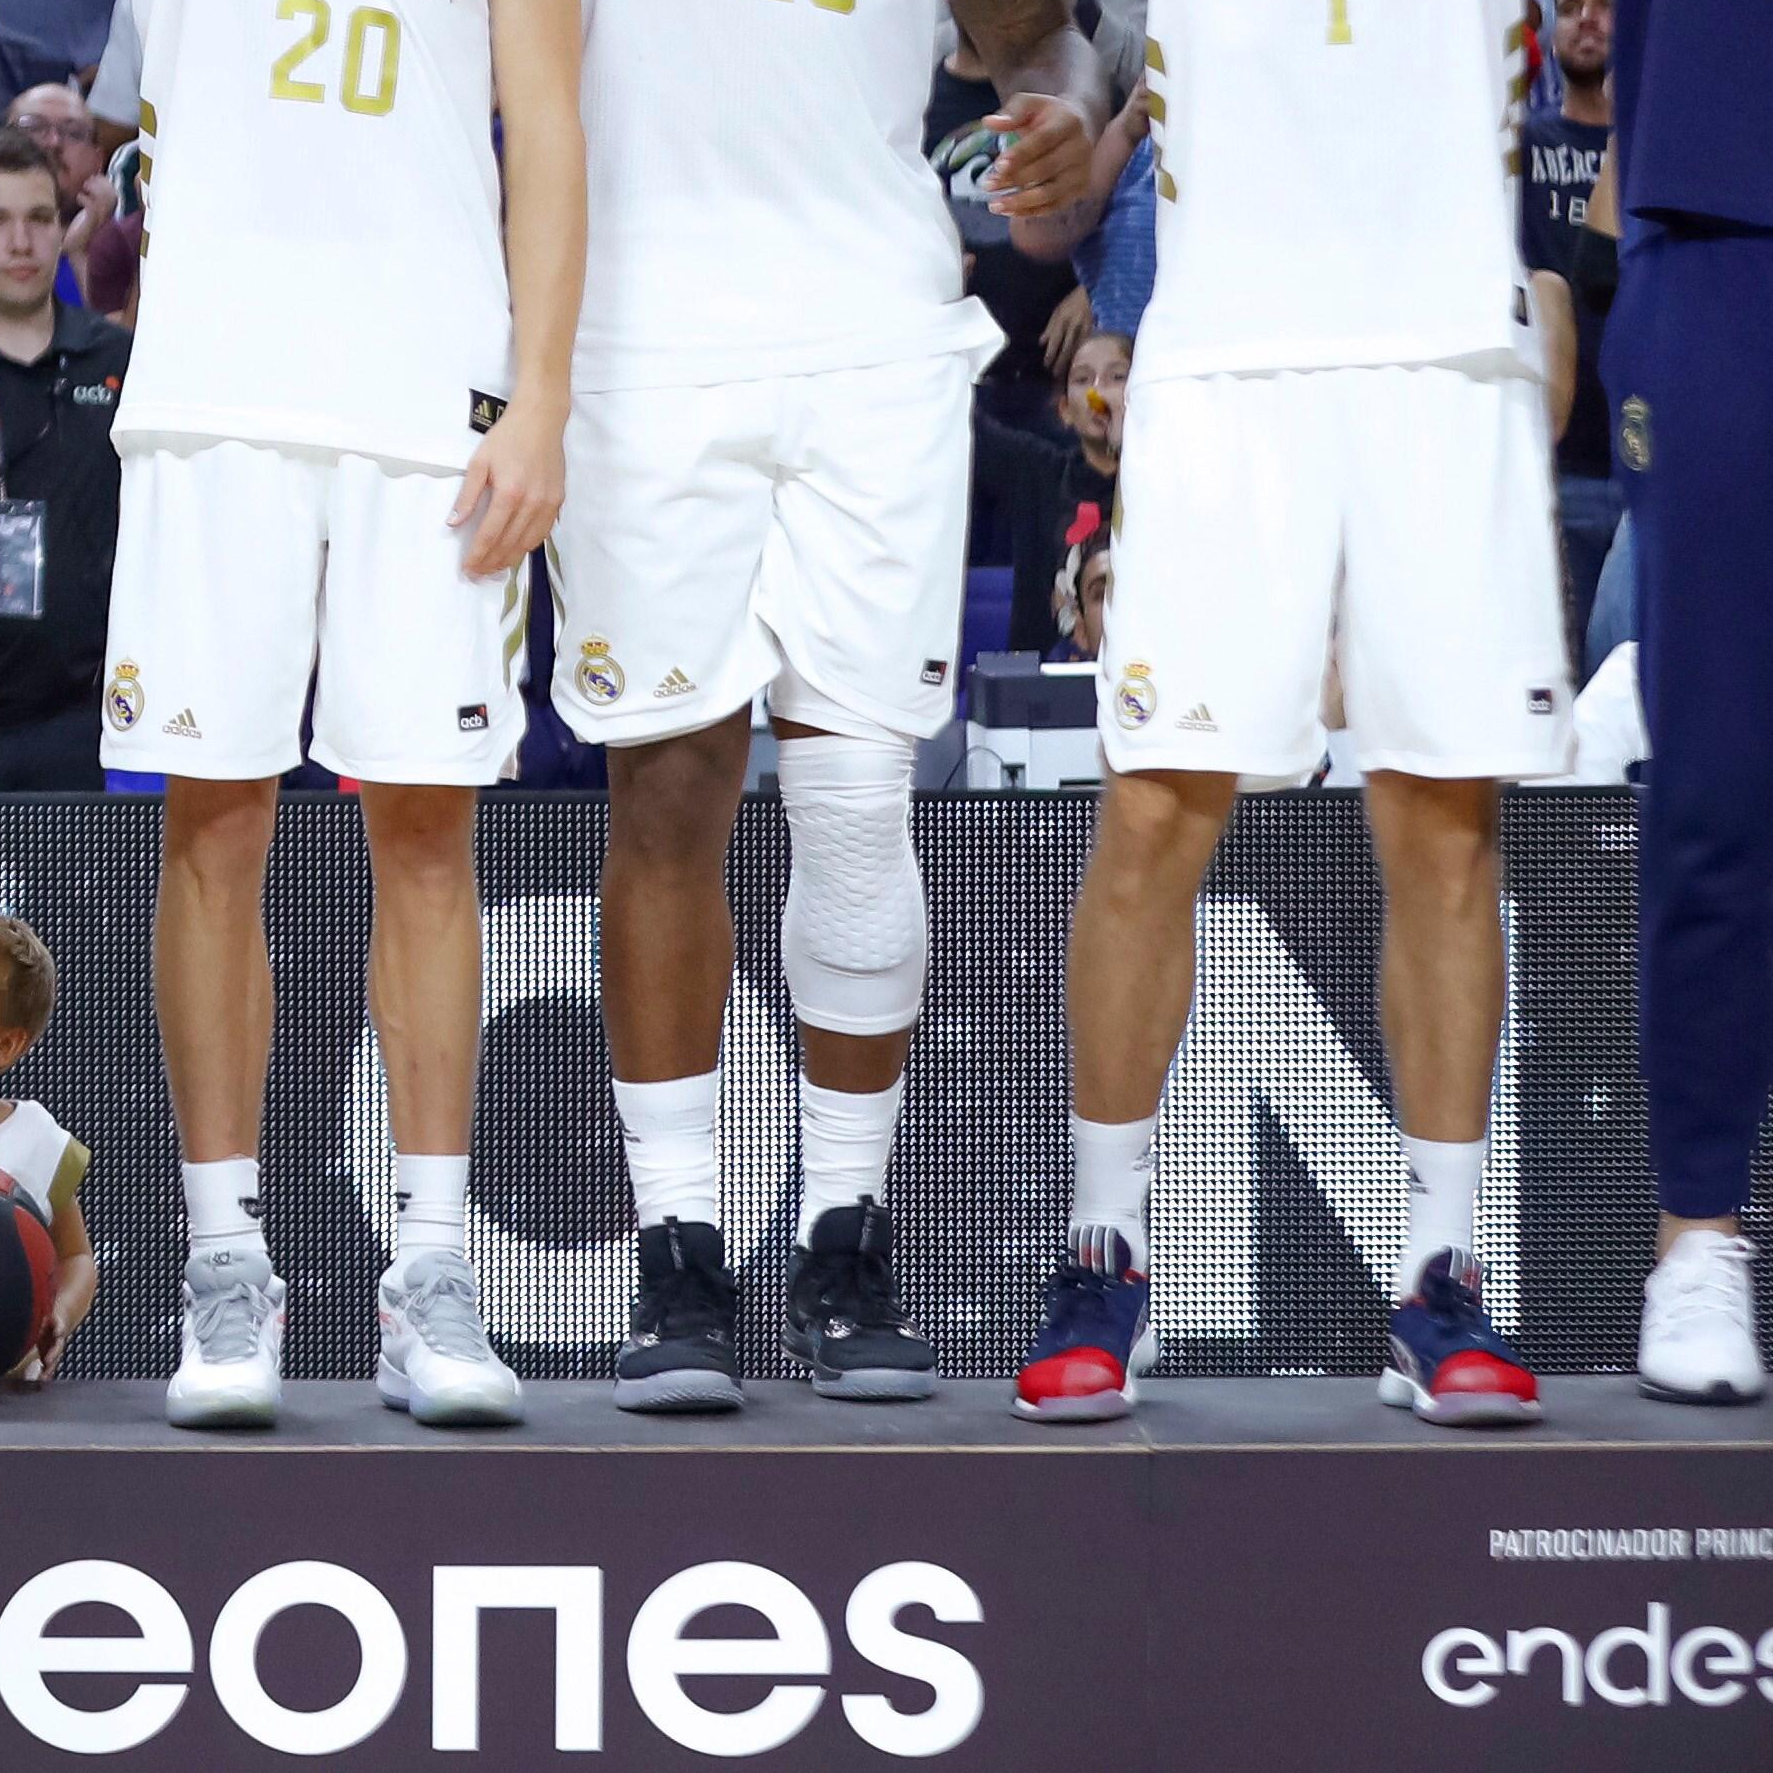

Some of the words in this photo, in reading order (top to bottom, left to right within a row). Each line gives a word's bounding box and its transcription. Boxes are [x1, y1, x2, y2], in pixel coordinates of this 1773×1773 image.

[460, 714, 485, 727] acb
[162, 724, 202, 739] adidas
[1489, 1528, 1694, 1560] PATROCINADOR
